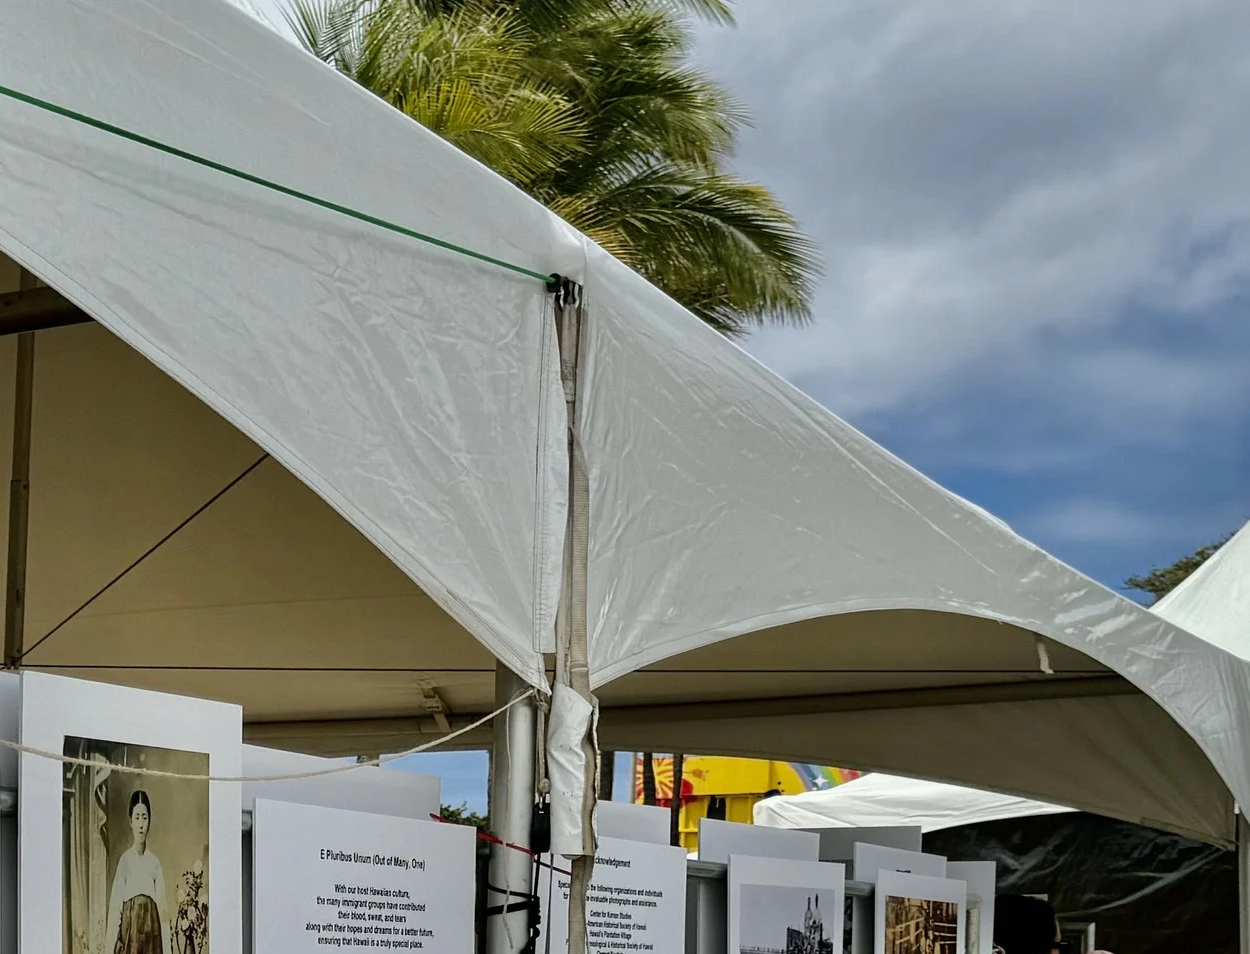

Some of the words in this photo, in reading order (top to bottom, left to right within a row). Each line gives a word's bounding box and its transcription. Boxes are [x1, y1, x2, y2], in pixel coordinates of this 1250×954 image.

[320, 848, 325, 859] E
[326, 849, 352, 862] Pluribus
[353, 852, 371, 863] Unum
[372, 854, 385, 866] (Out
[386, 856, 392, 866] of
[411, 858, 425, 871] One)
[595, 856, 630, 869] cknowledgement
